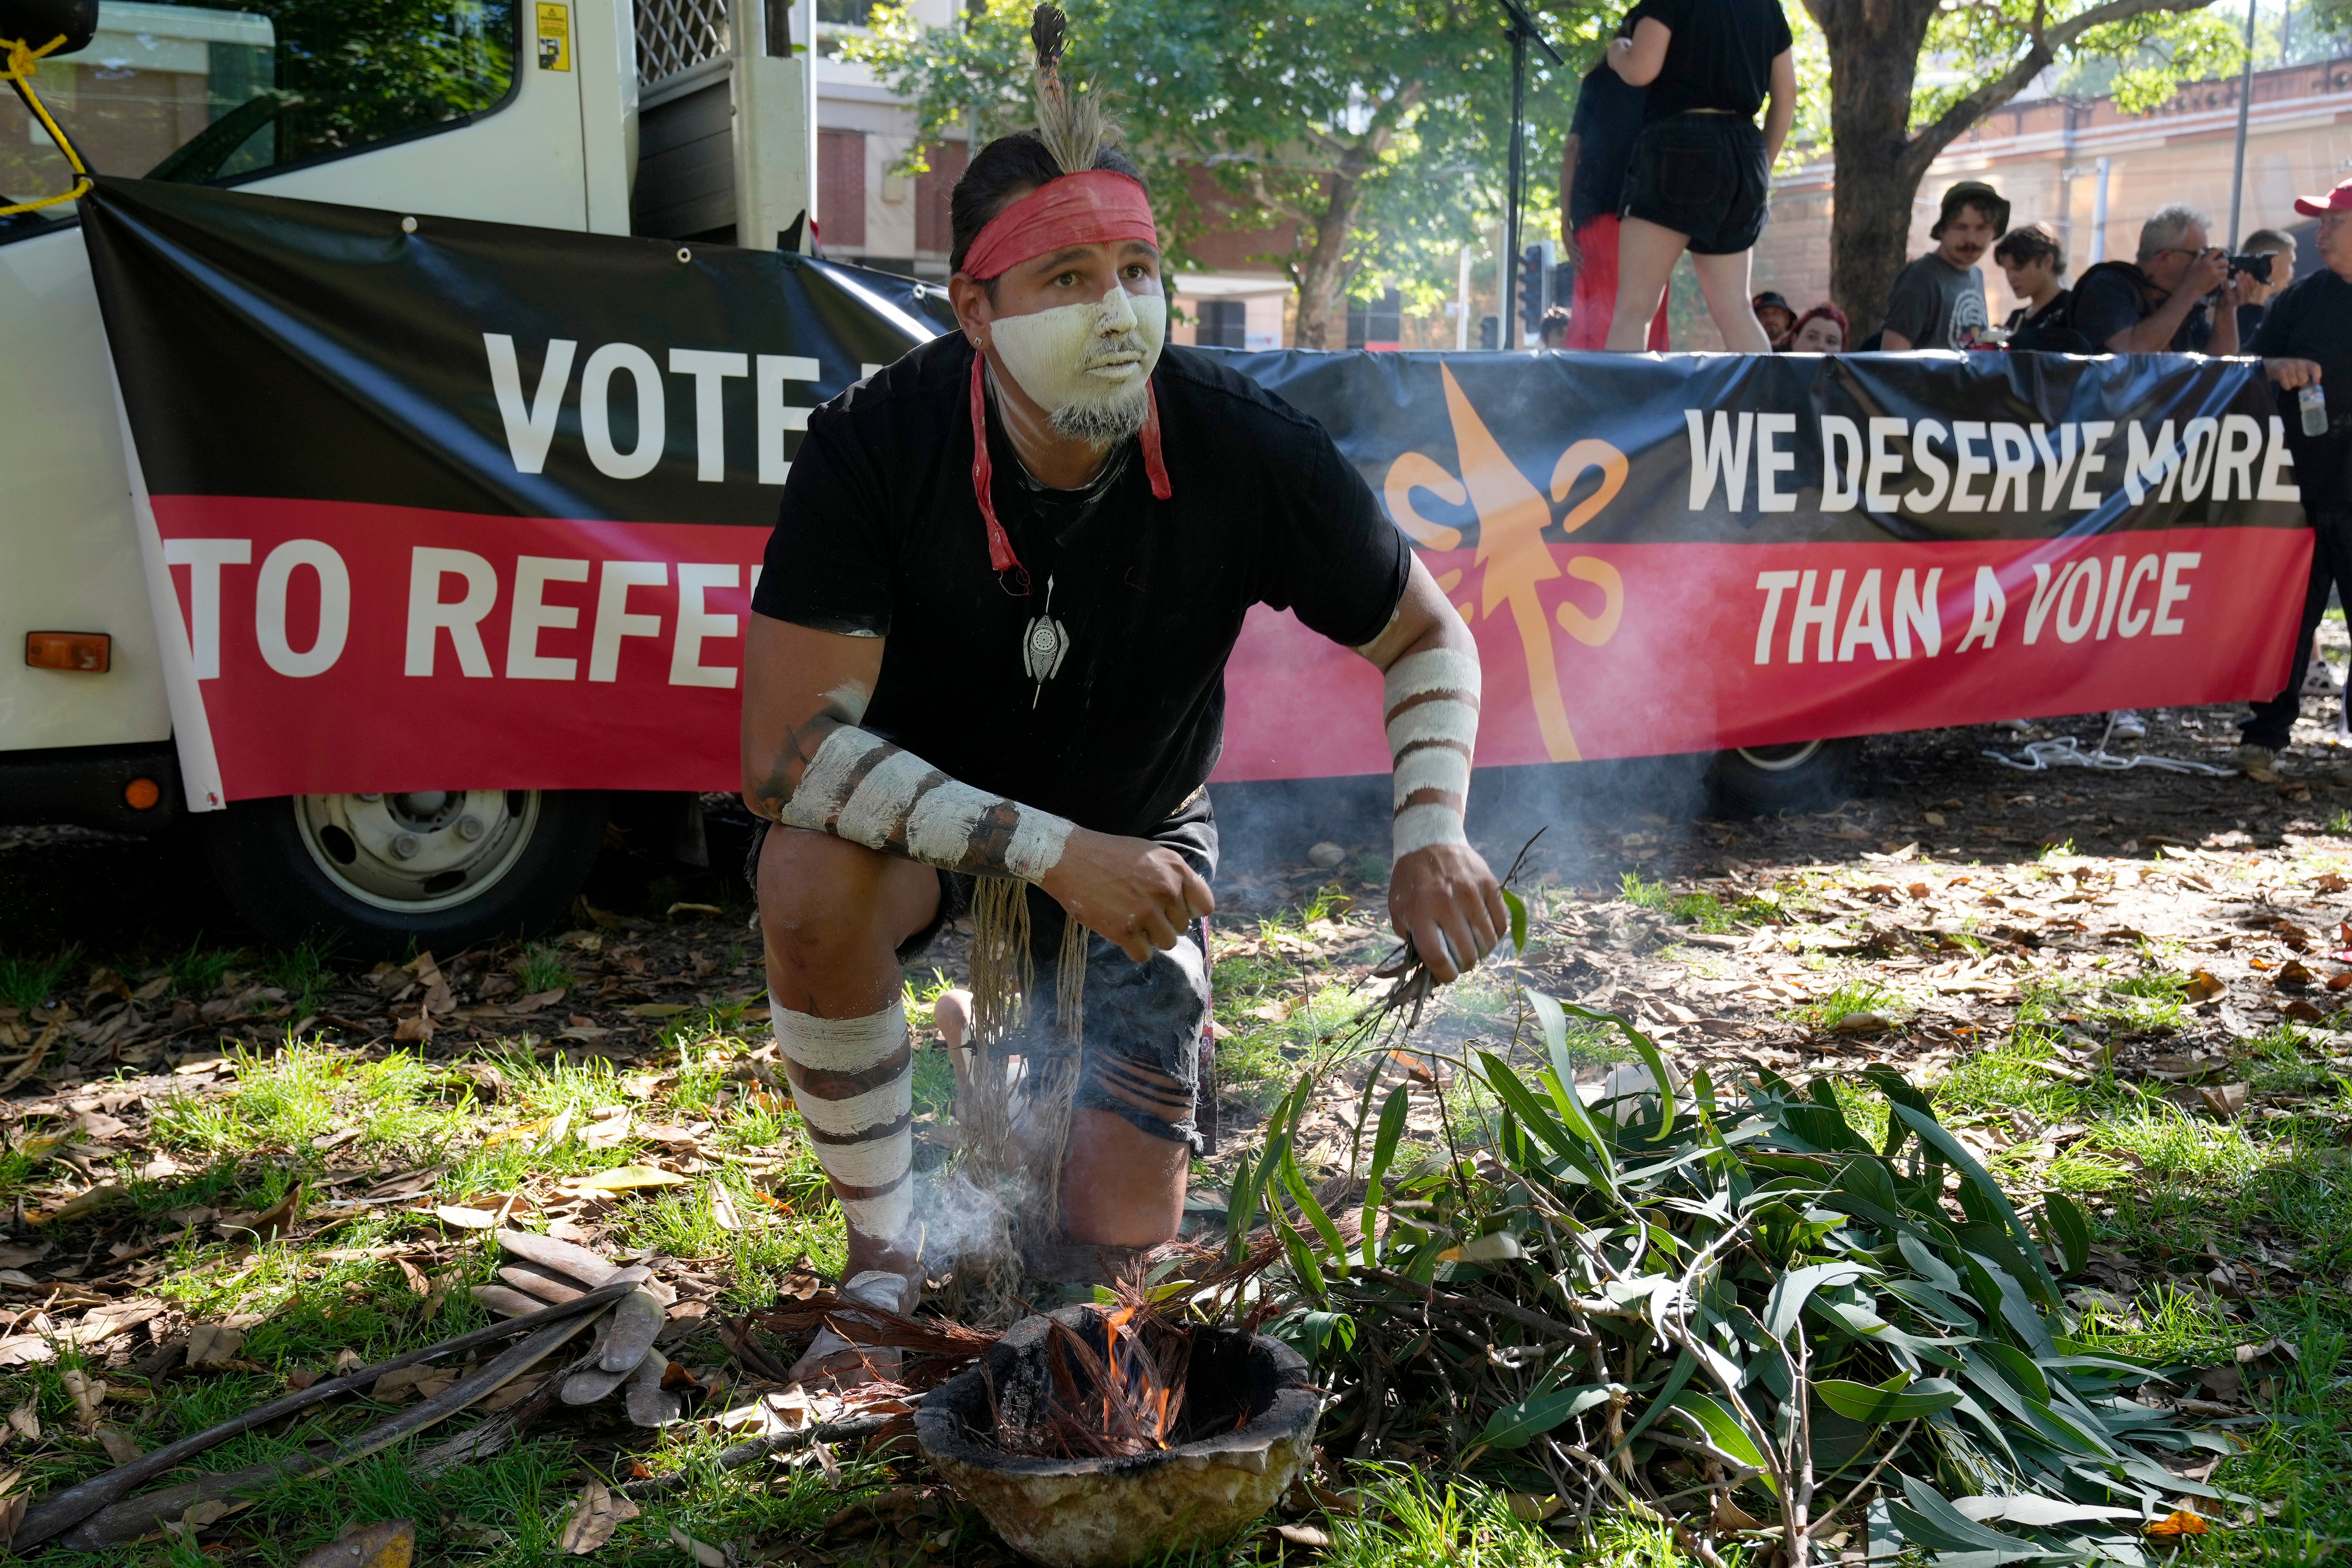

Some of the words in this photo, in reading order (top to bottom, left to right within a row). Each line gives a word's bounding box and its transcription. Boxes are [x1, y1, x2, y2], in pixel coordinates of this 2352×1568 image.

[483, 333, 820, 485] VOTE
[1684, 409, 1798, 513] WE
[1819, 414, 2116, 513] DESERVE
[2123, 414, 2301, 506] MORE
[163, 538, 350, 680] TO
[404, 546, 764, 688] REFE
[1754, 568, 1943, 665] THAN
[1955, 566, 2006, 653] A
[2023, 552, 2201, 645] VOICE
